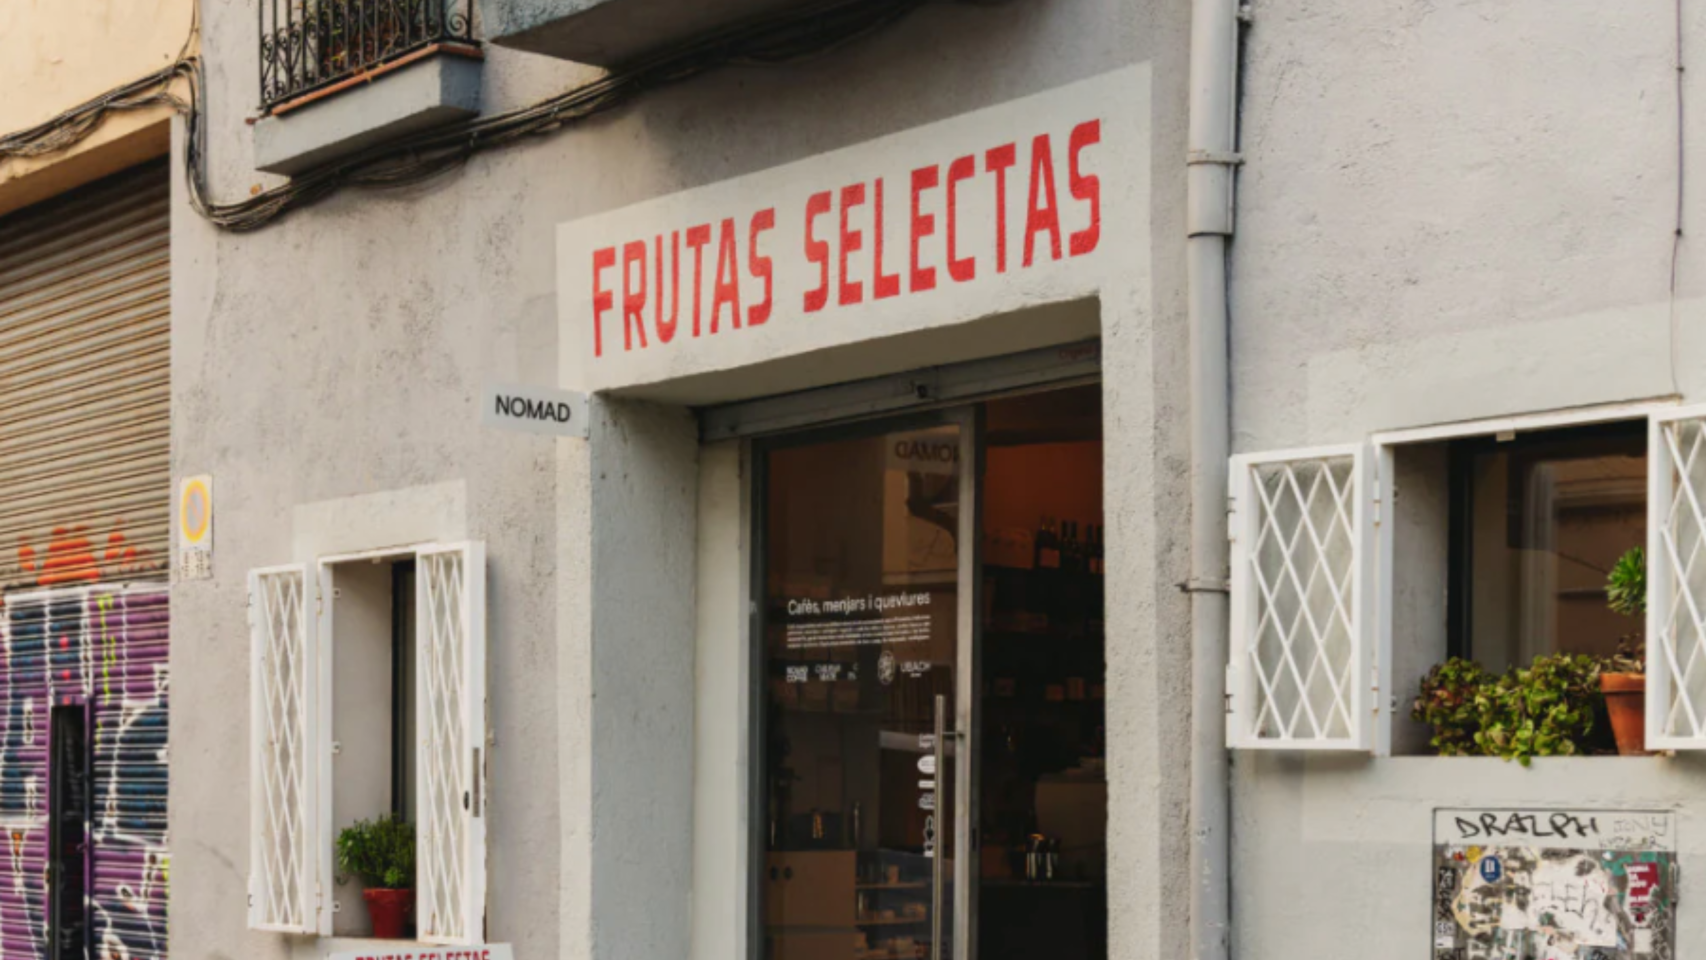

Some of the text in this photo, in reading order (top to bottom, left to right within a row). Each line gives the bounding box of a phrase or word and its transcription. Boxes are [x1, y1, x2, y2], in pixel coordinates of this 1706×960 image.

[592, 118, 1101, 357] FRUTAS SELECTAS
[495, 395, 571, 422] NOMAD
[823, 595, 865, 615] menjars
[868, 594, 873, 609] i
